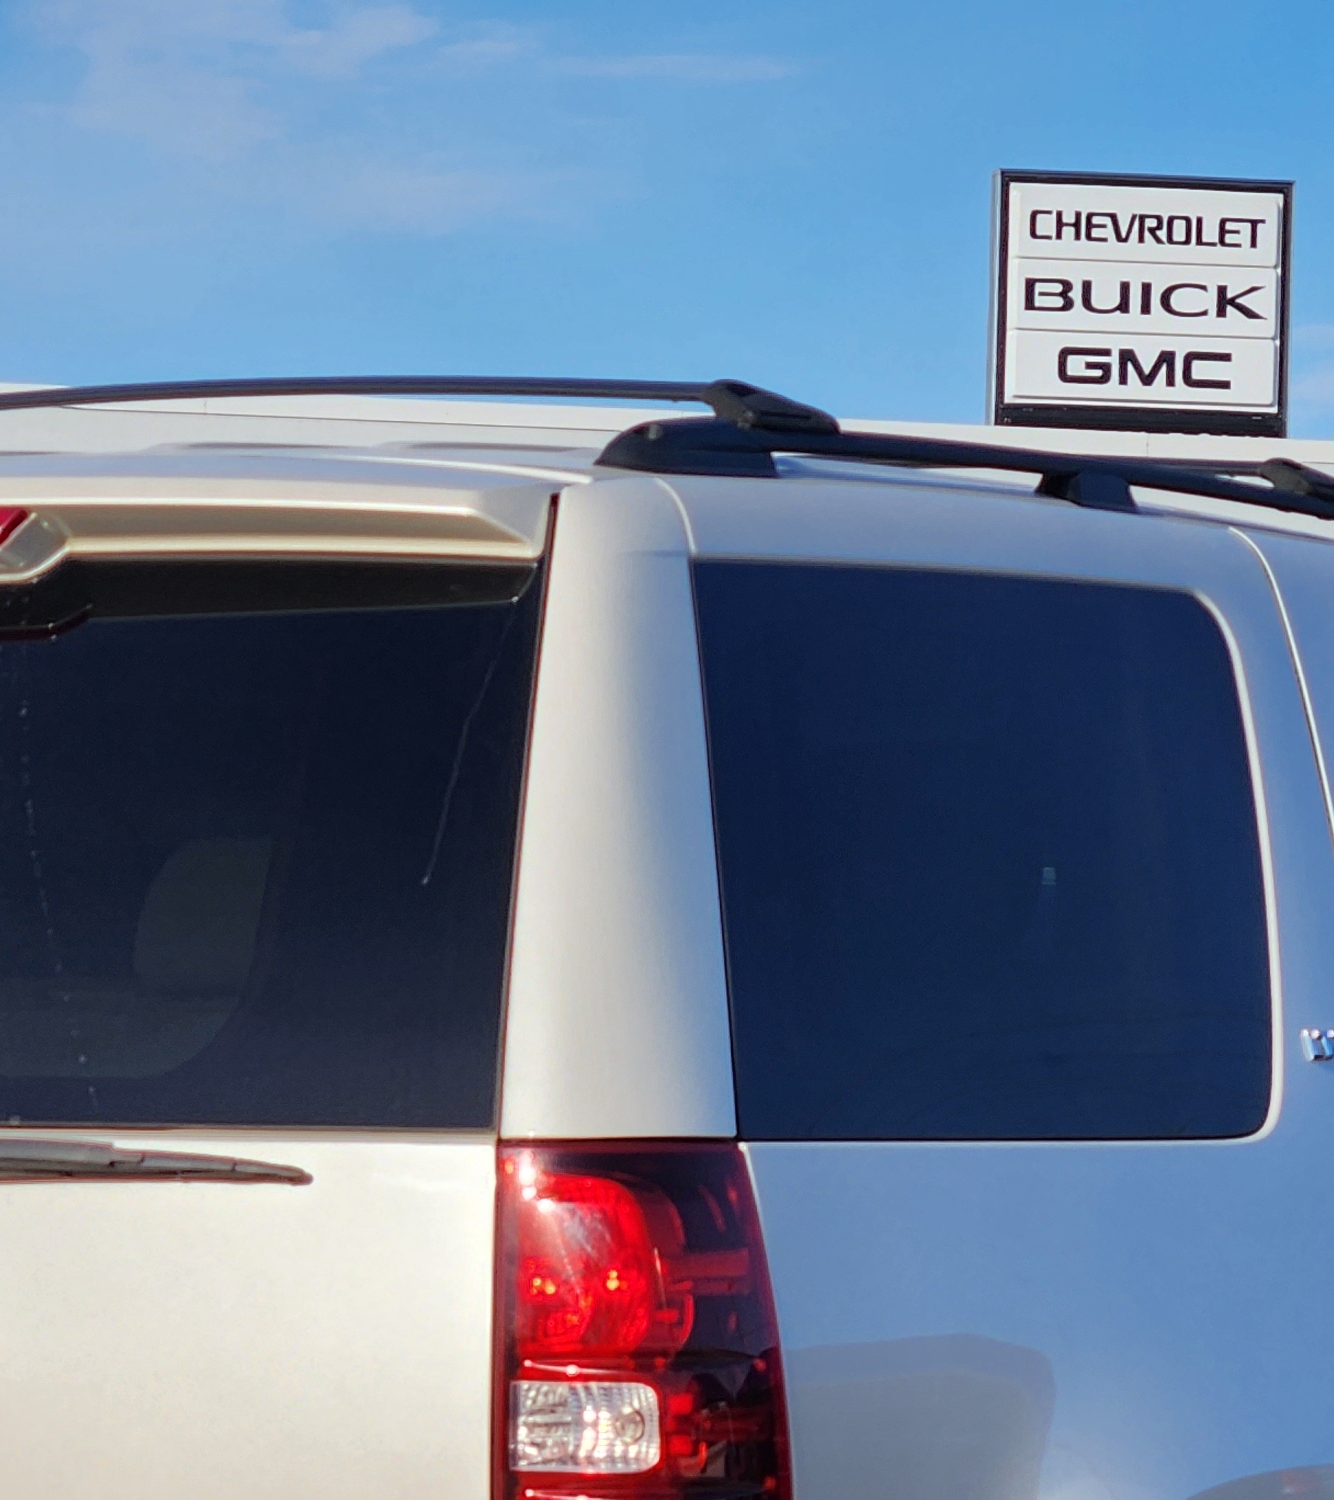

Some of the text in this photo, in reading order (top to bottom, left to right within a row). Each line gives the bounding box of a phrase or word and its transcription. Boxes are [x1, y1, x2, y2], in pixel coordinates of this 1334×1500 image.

[1029, 209, 1266, 249] CHEVROLET
[1023, 277, 1268, 320] BUICK
[1058, 346, 1233, 390] GMC
